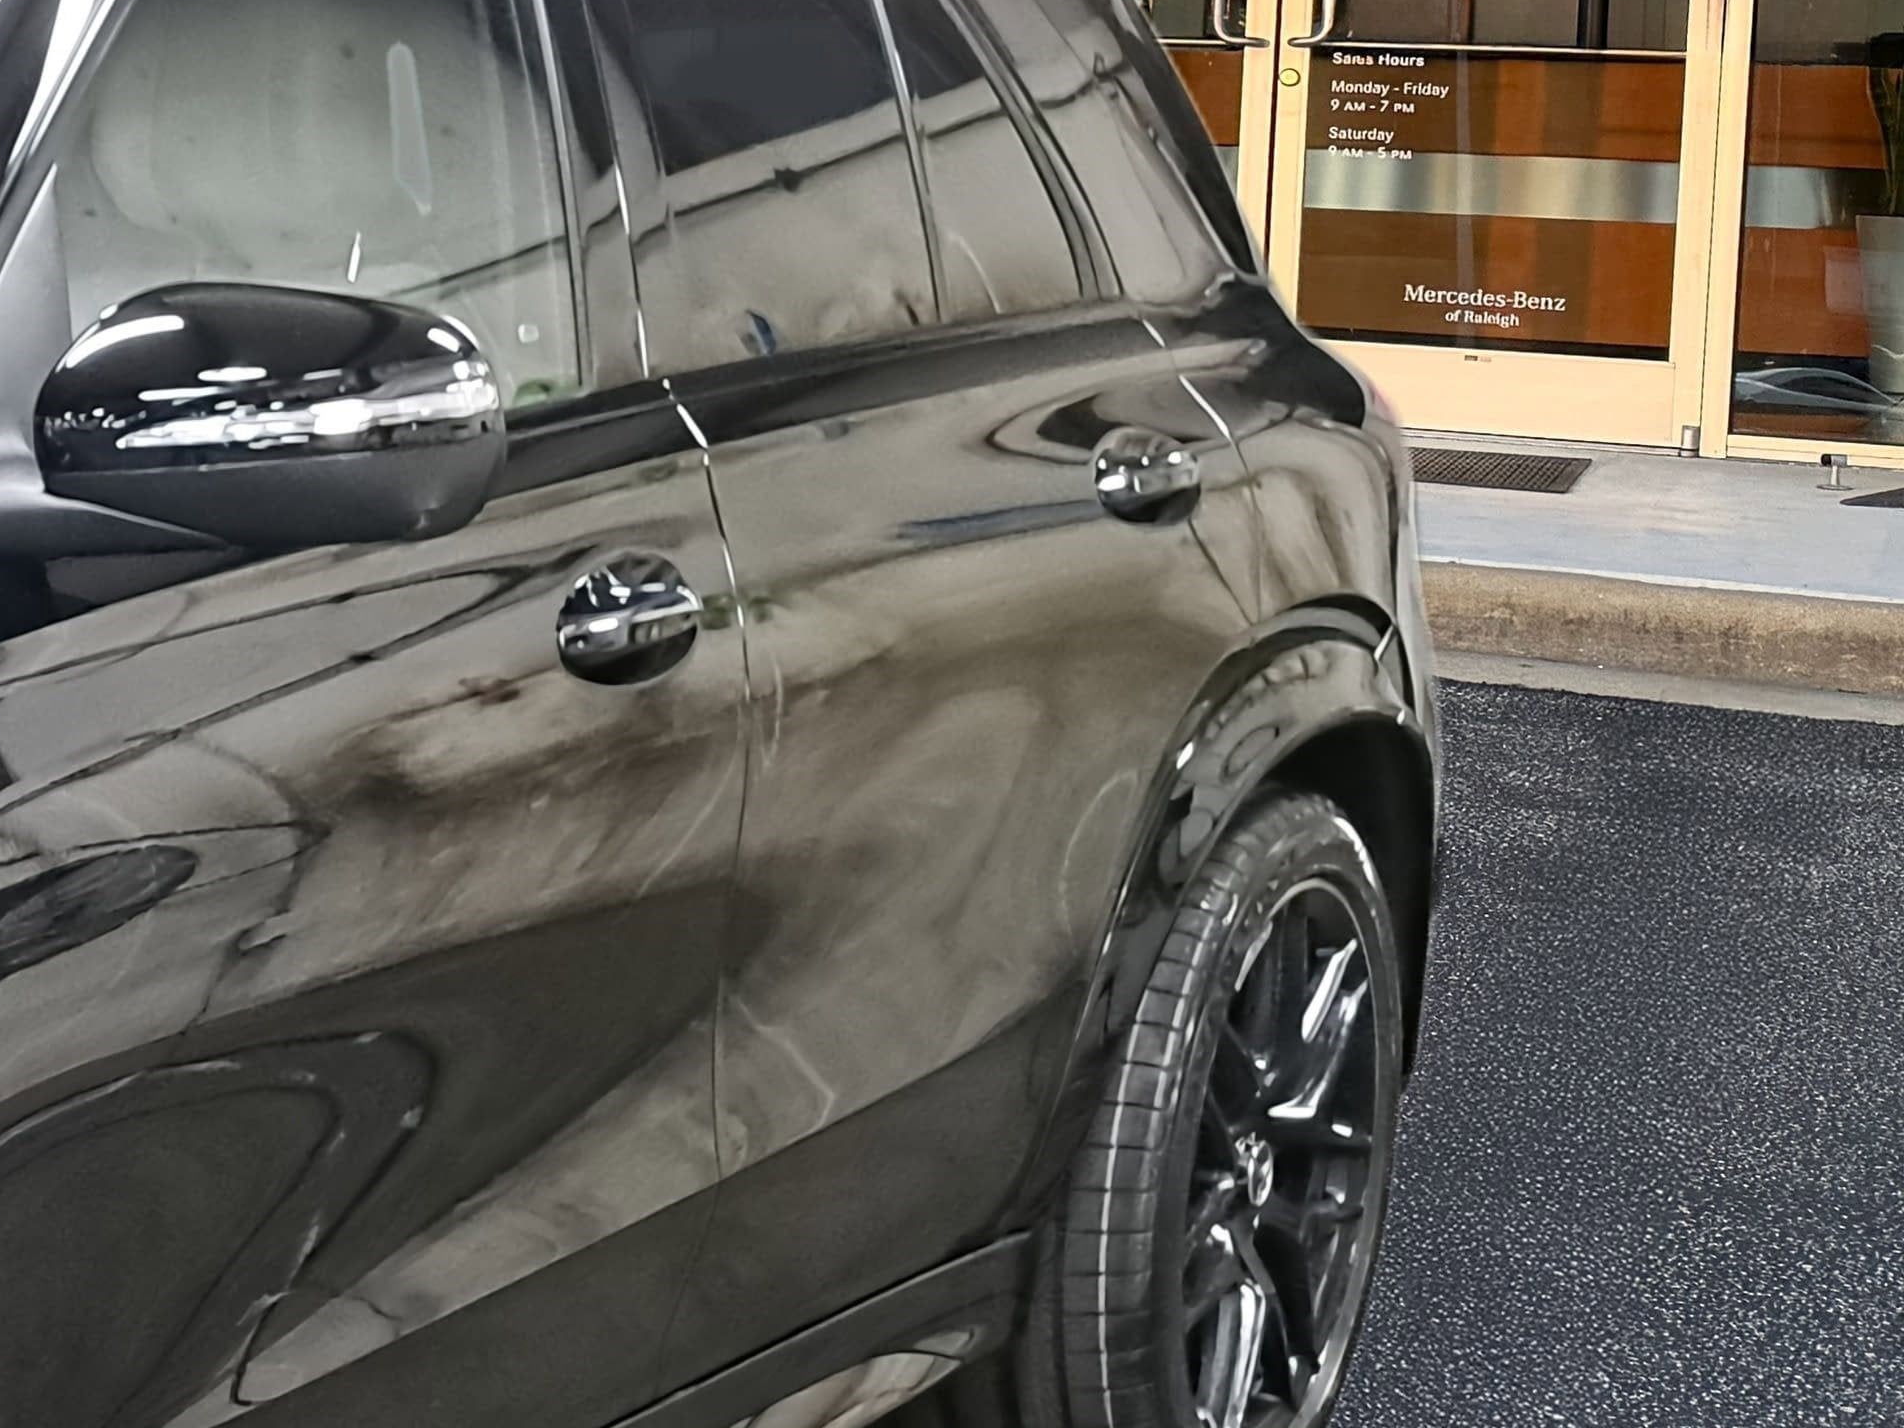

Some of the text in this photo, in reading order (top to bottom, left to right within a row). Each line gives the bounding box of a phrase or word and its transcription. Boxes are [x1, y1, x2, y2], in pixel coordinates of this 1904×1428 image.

[1378, 53, 1425, 67] Hours
[1331, 80, 1390, 97] Monday
[1403, 82, 1449, 98] Friday
[1330, 99, 1340, 111] 9
[1343, 102, 1366, 111] AM
[1379, 100, 1389, 112] 7
[1393, 103, 1415, 113] PM
[1328, 127, 1394, 144] Saturday
[1391, 150, 1412, 160] PM
[1404, 284, 1566, 311] Mercedes-Benz
[1445, 310, 1520, 328] of Raleigh
